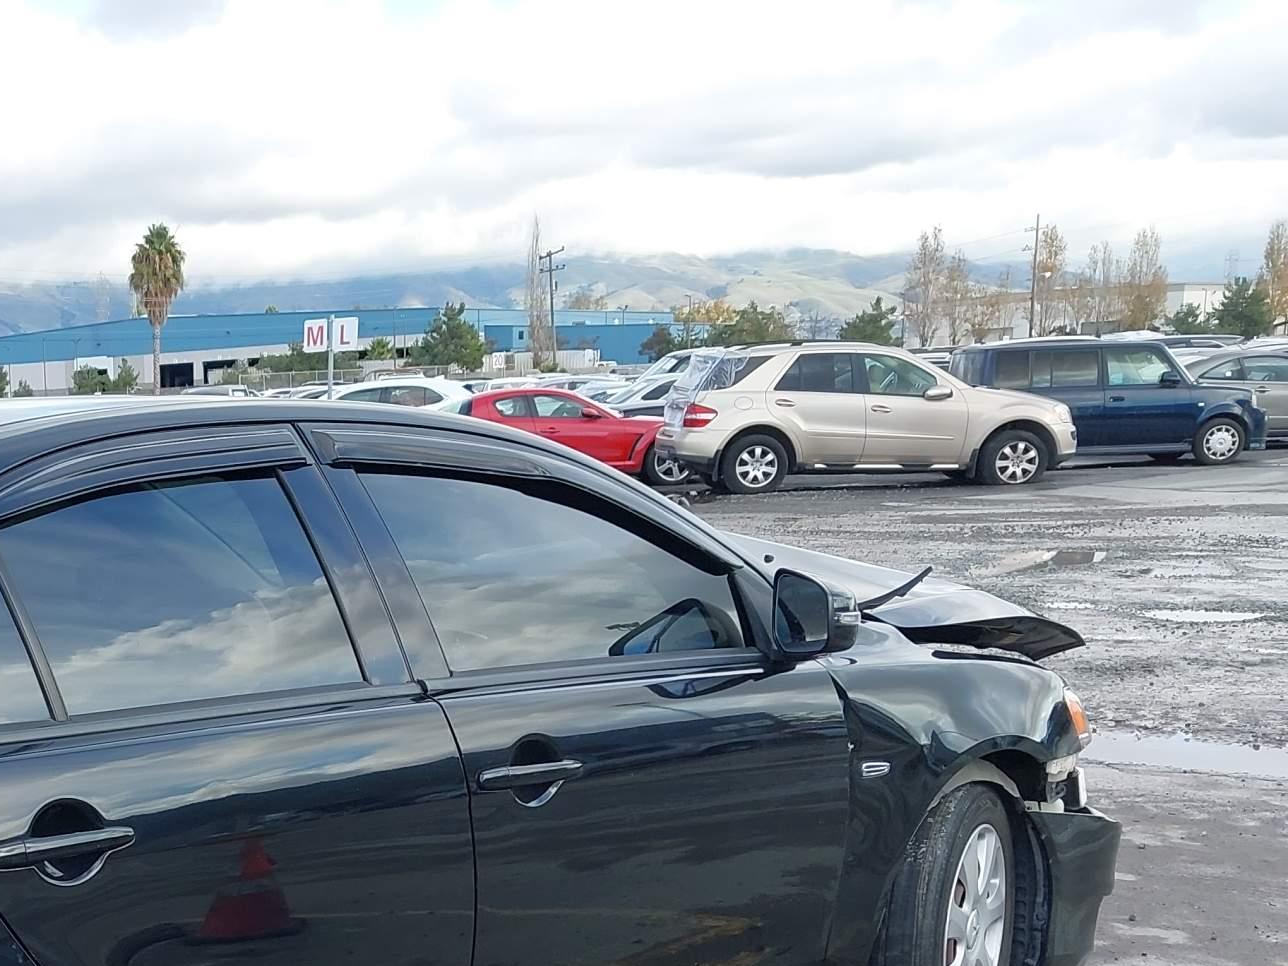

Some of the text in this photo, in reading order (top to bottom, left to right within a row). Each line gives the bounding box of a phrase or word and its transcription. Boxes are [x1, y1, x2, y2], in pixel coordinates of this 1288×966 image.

[307, 325, 324, 347] M
[339, 324, 351, 346] L
[493, 354, 504, 367] 20
